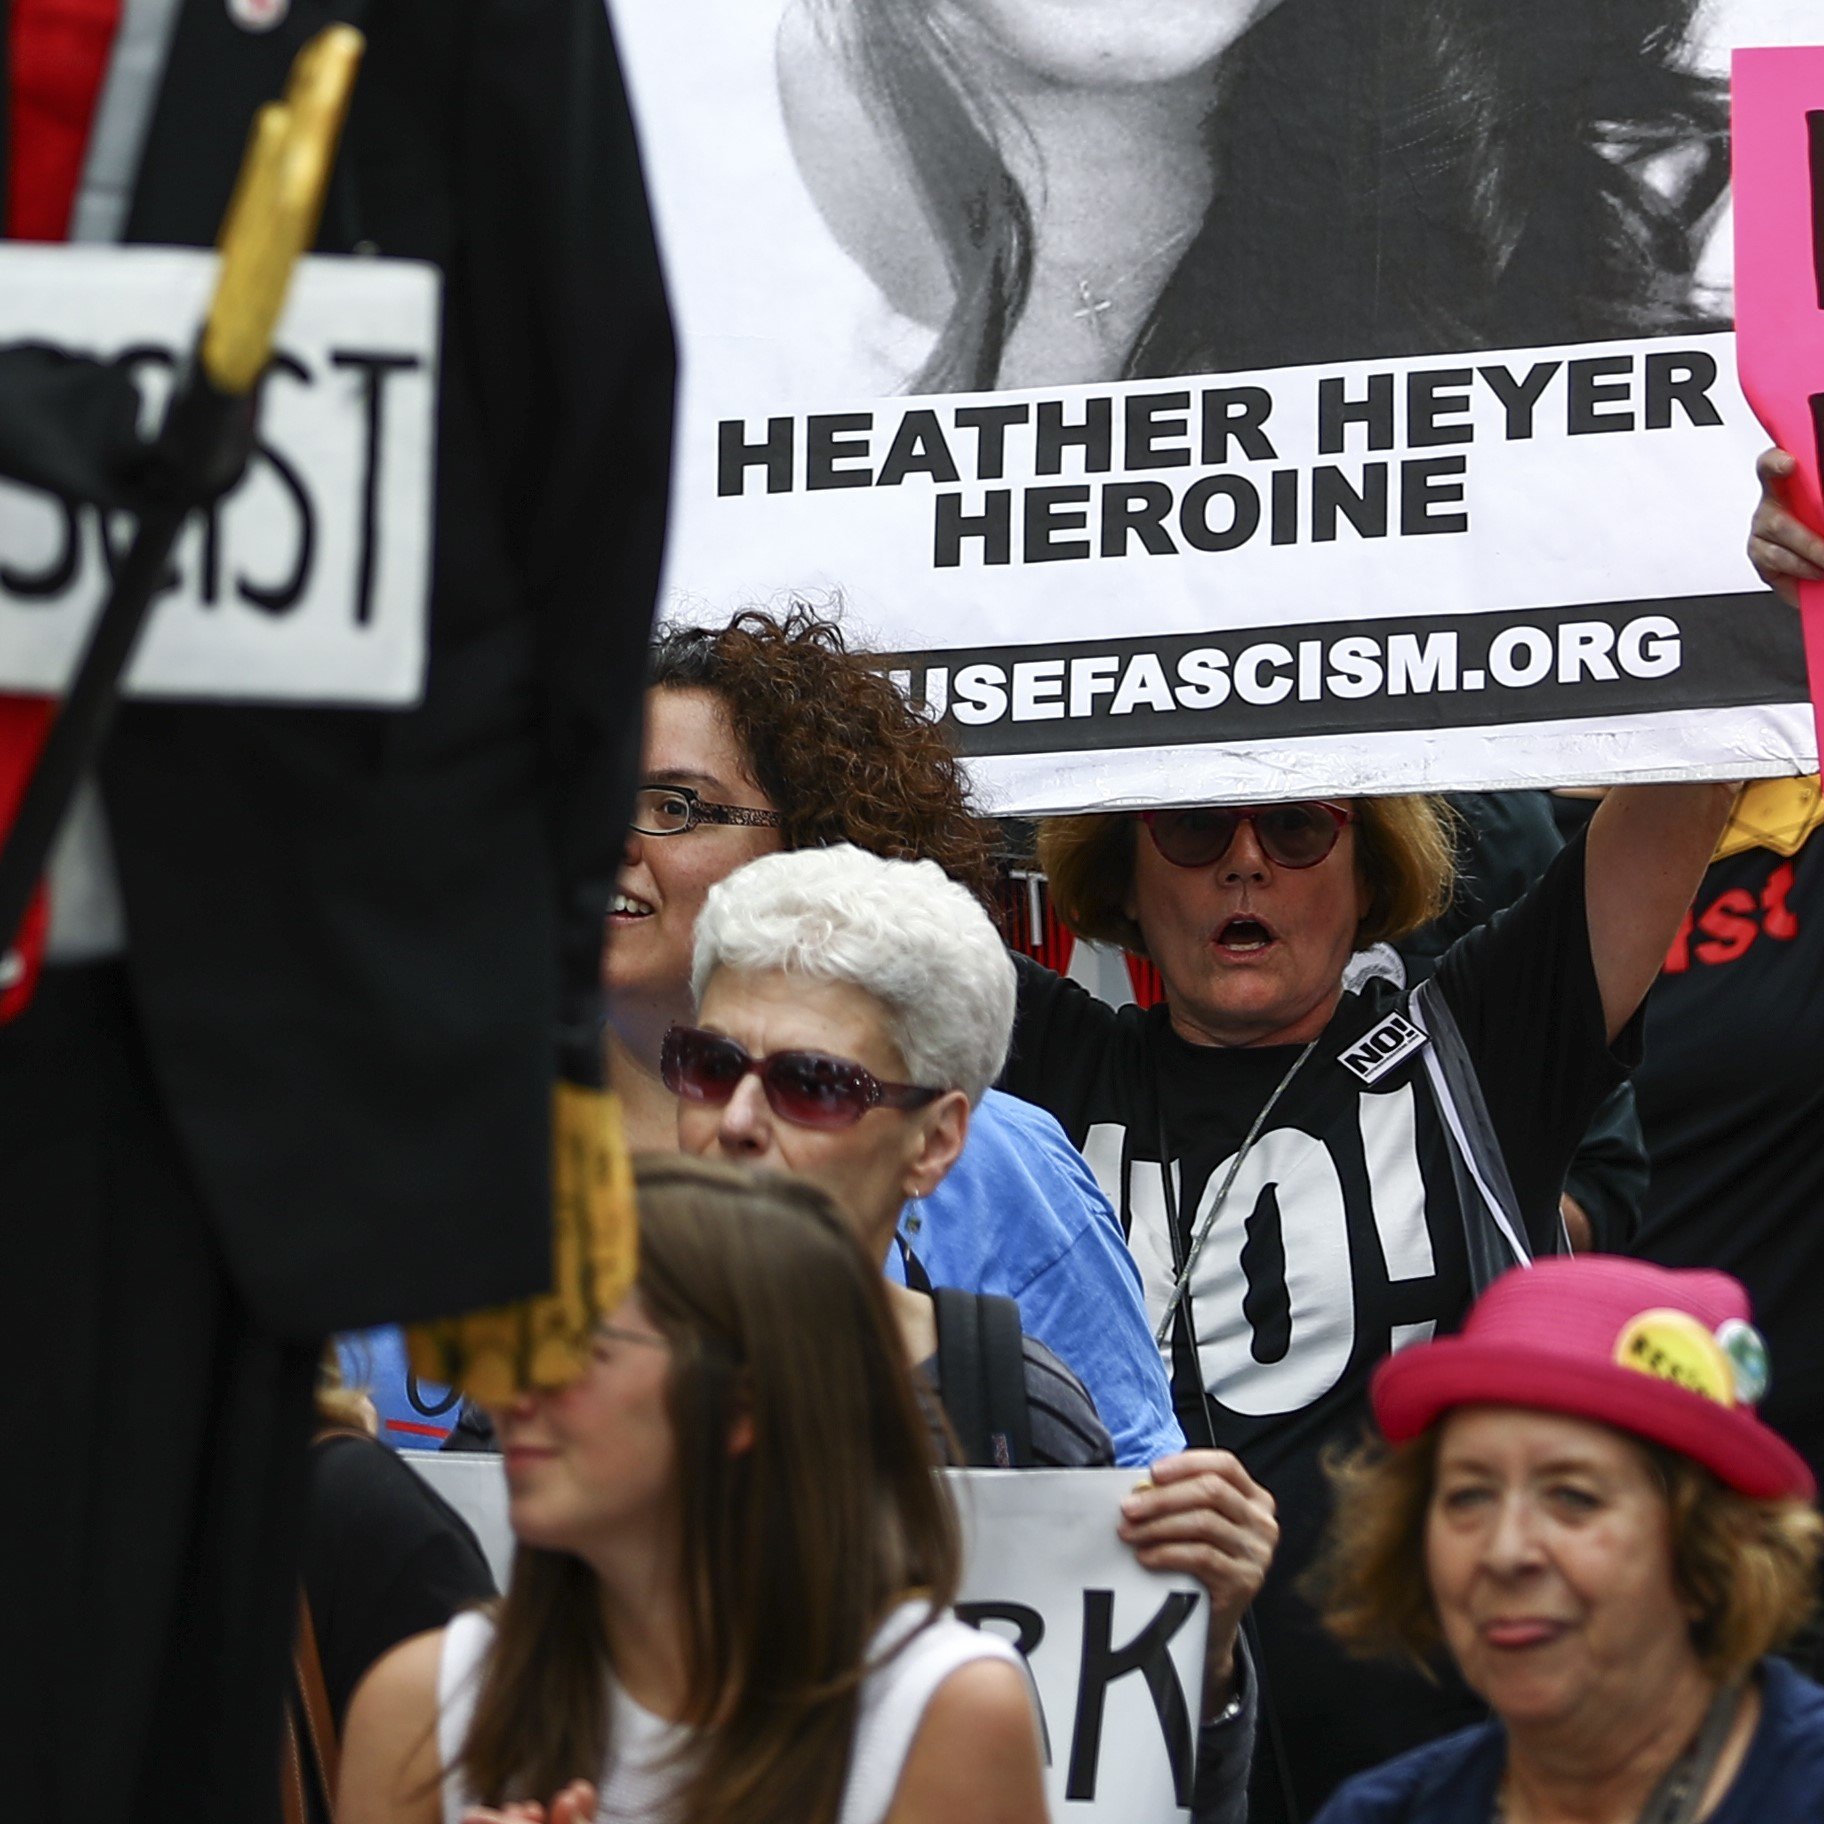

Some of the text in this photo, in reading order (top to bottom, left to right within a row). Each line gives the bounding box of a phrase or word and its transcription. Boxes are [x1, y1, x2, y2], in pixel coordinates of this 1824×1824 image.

[716, 350, 1725, 497] HEATHER HEYER
[933, 453, 1469, 569] HEROINE
[1344, 1017, 1417, 1075] NO!
[1082, 1080, 1437, 1418] NO!
